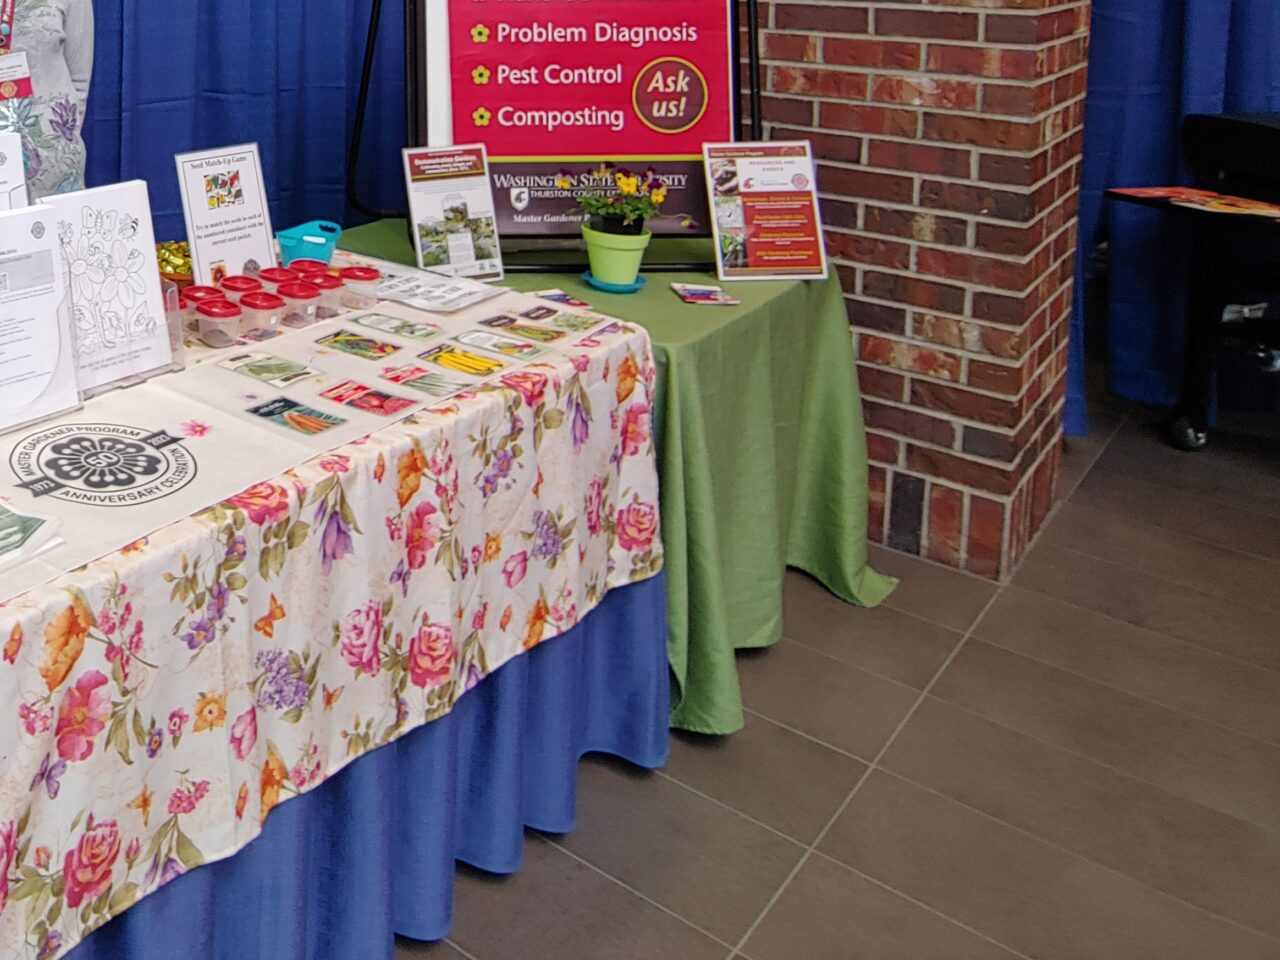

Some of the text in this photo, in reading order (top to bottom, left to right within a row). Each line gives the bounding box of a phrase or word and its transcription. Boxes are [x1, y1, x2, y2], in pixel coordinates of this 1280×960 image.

[497, 21, 698, 48] Problem Diagnosis
[497, 63, 623, 85] Pest Control
[647, 69, 691, 93] Ask
[651, 96, 687, 118] us!
[497, 105, 625, 132] Composting
[190, 161, 204, 170] Seed
[204, 157, 231, 168] Match-Up
[530, 190, 571, 198] THURSTON
[513, 213, 542, 223] Master
[543, 213, 584, 223] Gardener
[19, 426, 142, 477] MASTER GARDENER PROGRAM
[86, 452, 119, 468] 50
[61, 447, 190, 503] ANNIVERSARY CELEBRATION
